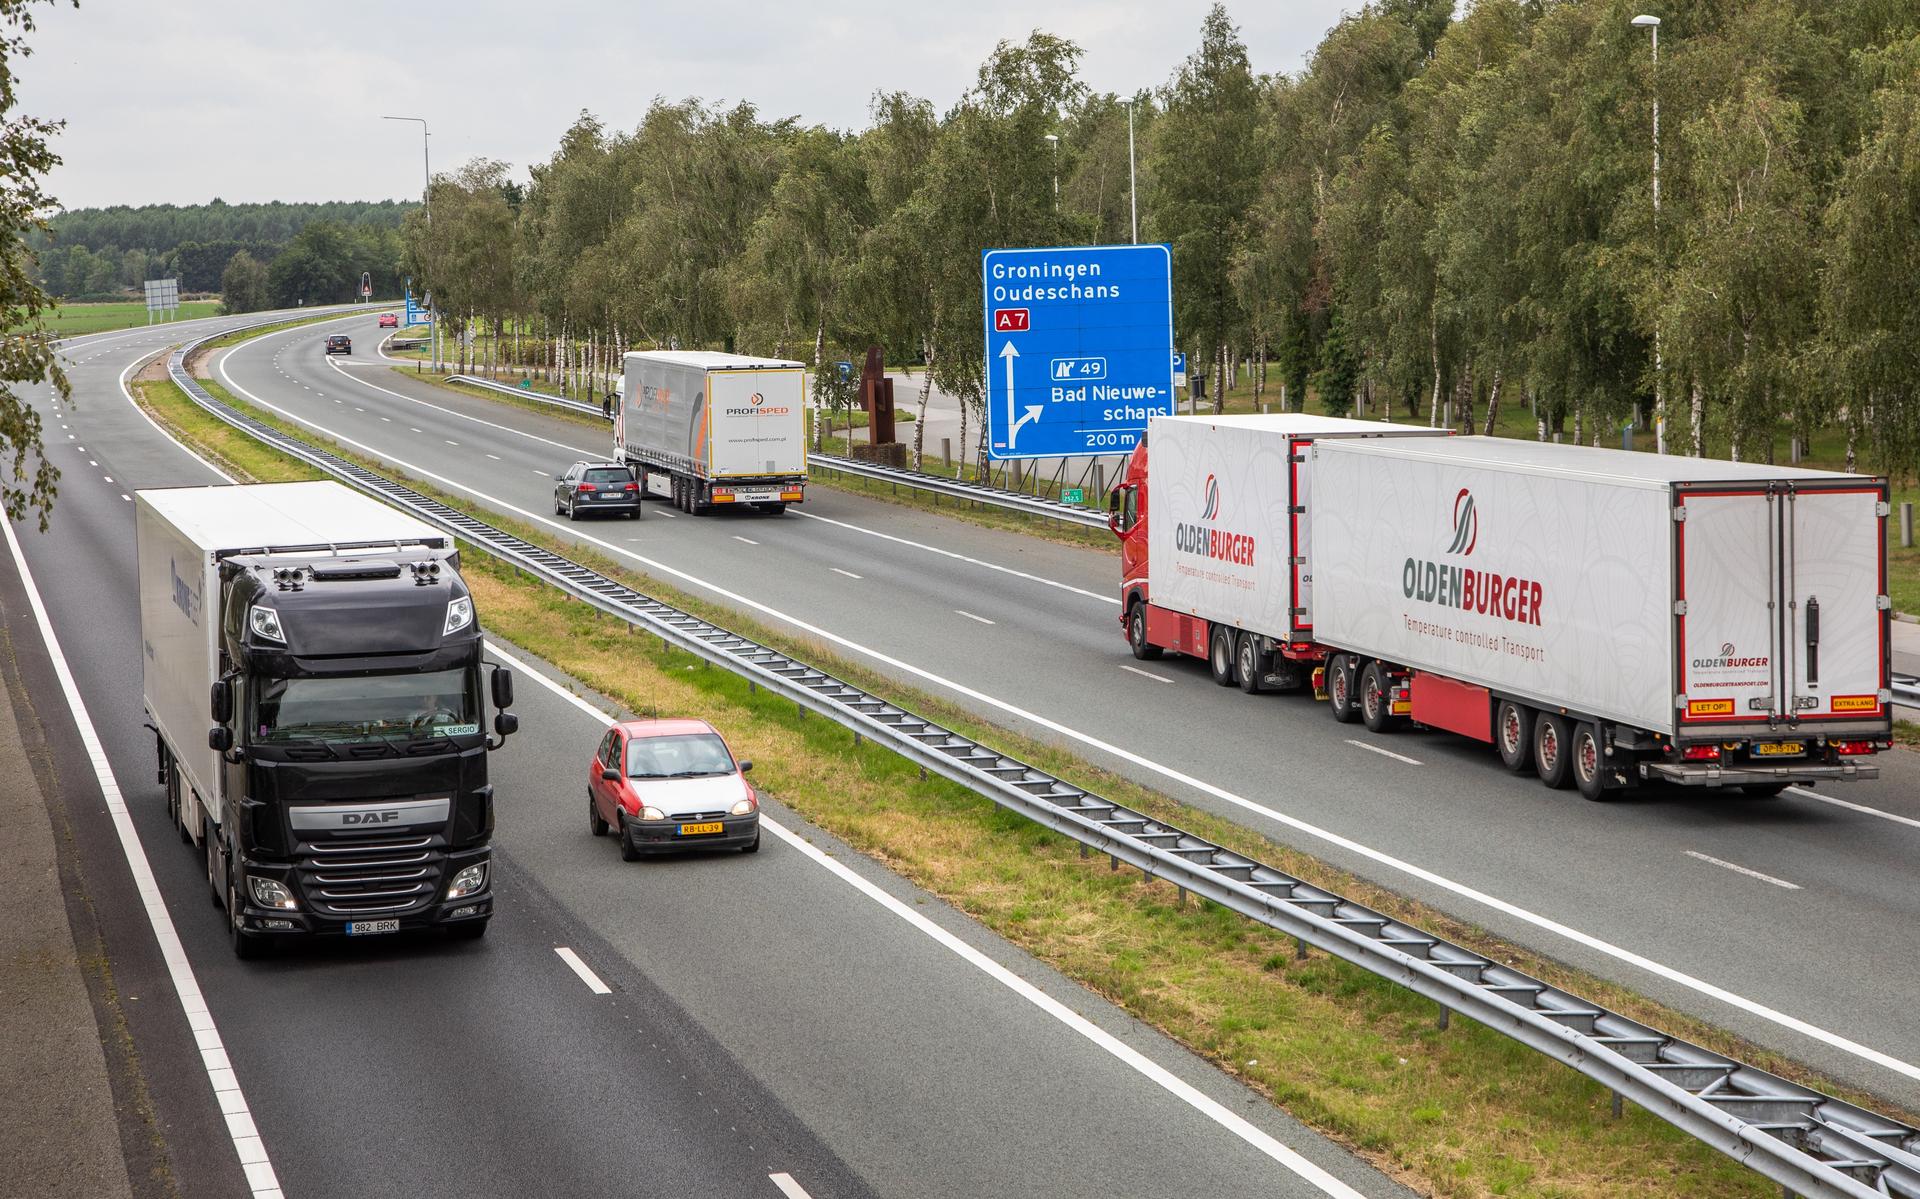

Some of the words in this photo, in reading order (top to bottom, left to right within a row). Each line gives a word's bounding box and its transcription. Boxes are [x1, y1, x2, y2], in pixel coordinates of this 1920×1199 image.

[993, 262, 1101, 281] Groningen
[993, 284, 1120, 302] Oudeschans
[1080, 362, 1101, 375] 49
[1051, 386, 1086, 403] Bad
[1092, 385, 1166, 402] Nieuwe-
[726, 407, 789, 415] PROFISPED
[1103, 405, 1167, 421] schans
[1086, 433, 1117, 446] 200
[1121, 434, 1135, 445] m
[1176, 522, 1254, 567] OLDENBURGER
[1402, 557, 1543, 626] OLDENBURGER
[1403, 614, 1452, 640] Temperature
[1455, 628, 1499, 651] controlled
[1501, 636, 1544, 662] Transport
[1692, 657, 1769, 668] OLDENBURGER
[1696, 703, 1710, 711] LET
[1713, 703, 1727, 711] OP!
[448, 726, 475, 735] SERGIO
[342, 811, 399, 825] DAF
[683, 824, 719, 833] RB-LL-39
[354, 923, 371, 932] 982
[376, 921, 396, 930] BRK
